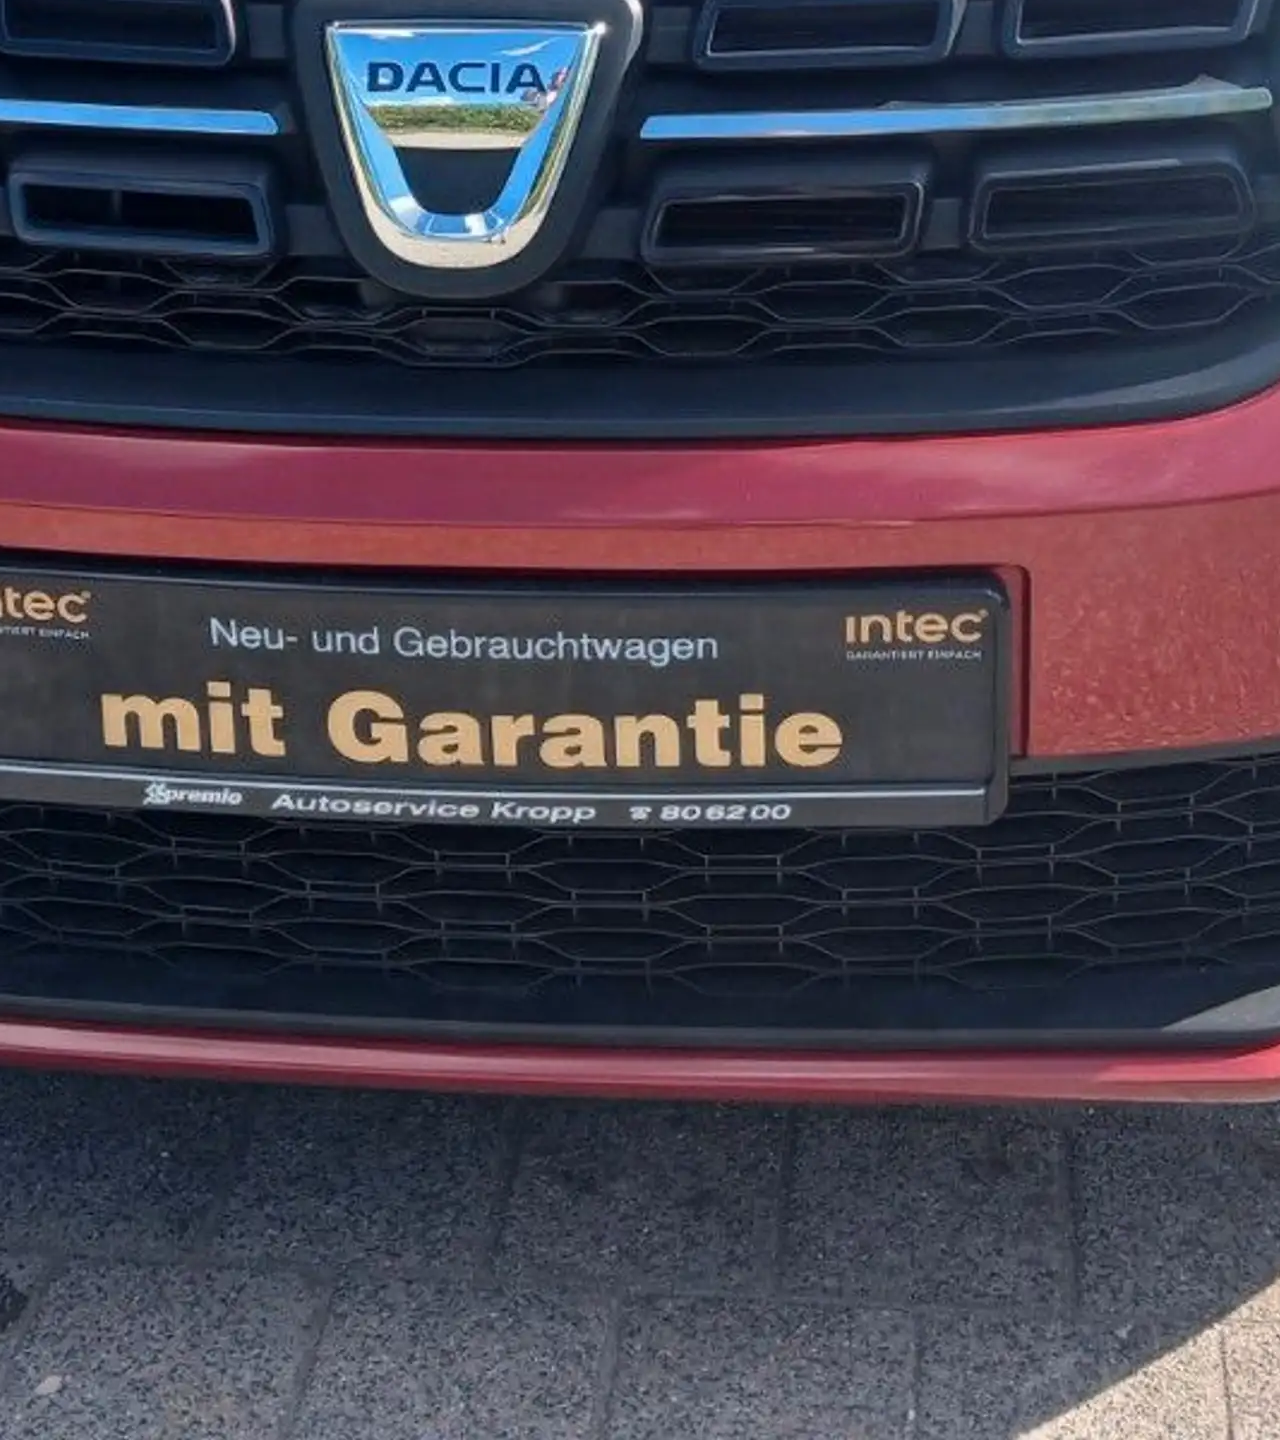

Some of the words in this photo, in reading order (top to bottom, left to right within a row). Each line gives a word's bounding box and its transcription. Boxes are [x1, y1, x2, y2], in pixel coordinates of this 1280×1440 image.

[367, 62, 546, 94] DACIA
[209, 617, 298, 651] Neu-
[312, 626, 380, 655] und
[393, 626, 719, 667] Gebrauchtwagen
[845, 610, 985, 644] intec
[100, 681, 286, 757] mit
[327, 689, 843, 768] Garantie
[165, 787, 243, 806] premio
[271, 792, 480, 819] Autoservice
[490, 801, 597, 824] Kropp
